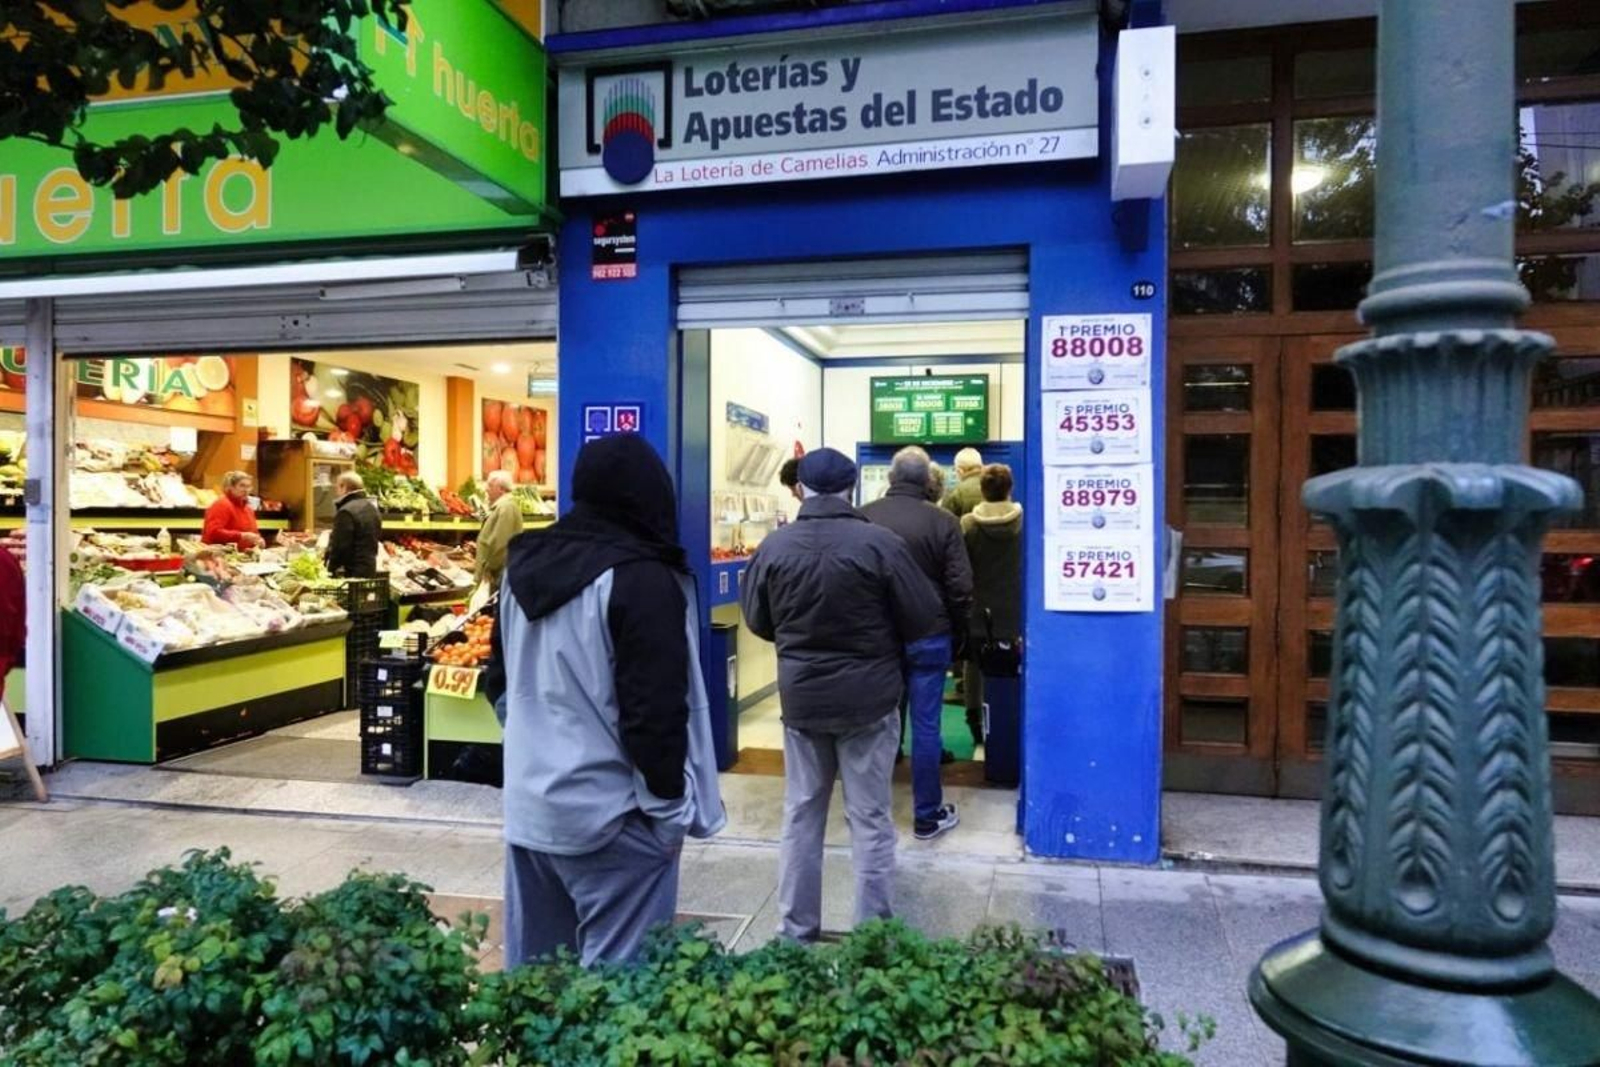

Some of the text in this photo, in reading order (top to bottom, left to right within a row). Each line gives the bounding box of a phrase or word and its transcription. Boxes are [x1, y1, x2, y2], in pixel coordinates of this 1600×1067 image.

[685, 54, 862, 98] Loterías y
[432, 41, 540, 162] huerta
[683, 78, 1064, 150] Apuestas del Estado
[654, 168, 674, 184] La
[751, 160, 773, 176] de
[780, 153, 869, 174] Camelias
[877, 140, 1010, 167] Administración
[1039, 135, 1061, 154] 27
[1133, 284, 1154, 296] 110
[1070, 324, 1135, 336] PREMIO
[1051, 336, 1143, 358] 88008
[1076, 403, 1130, 414] PREMIO
[1059, 413, 1136, 432] 45353
[1078, 478, 1131, 489] PREMIO
[1061, 489, 1137, 507] 88979
[1078, 551, 1132, 561] PREMIO
[1062, 561, 1135, 579] 57421
[433, 668, 475, 695] 0.99
